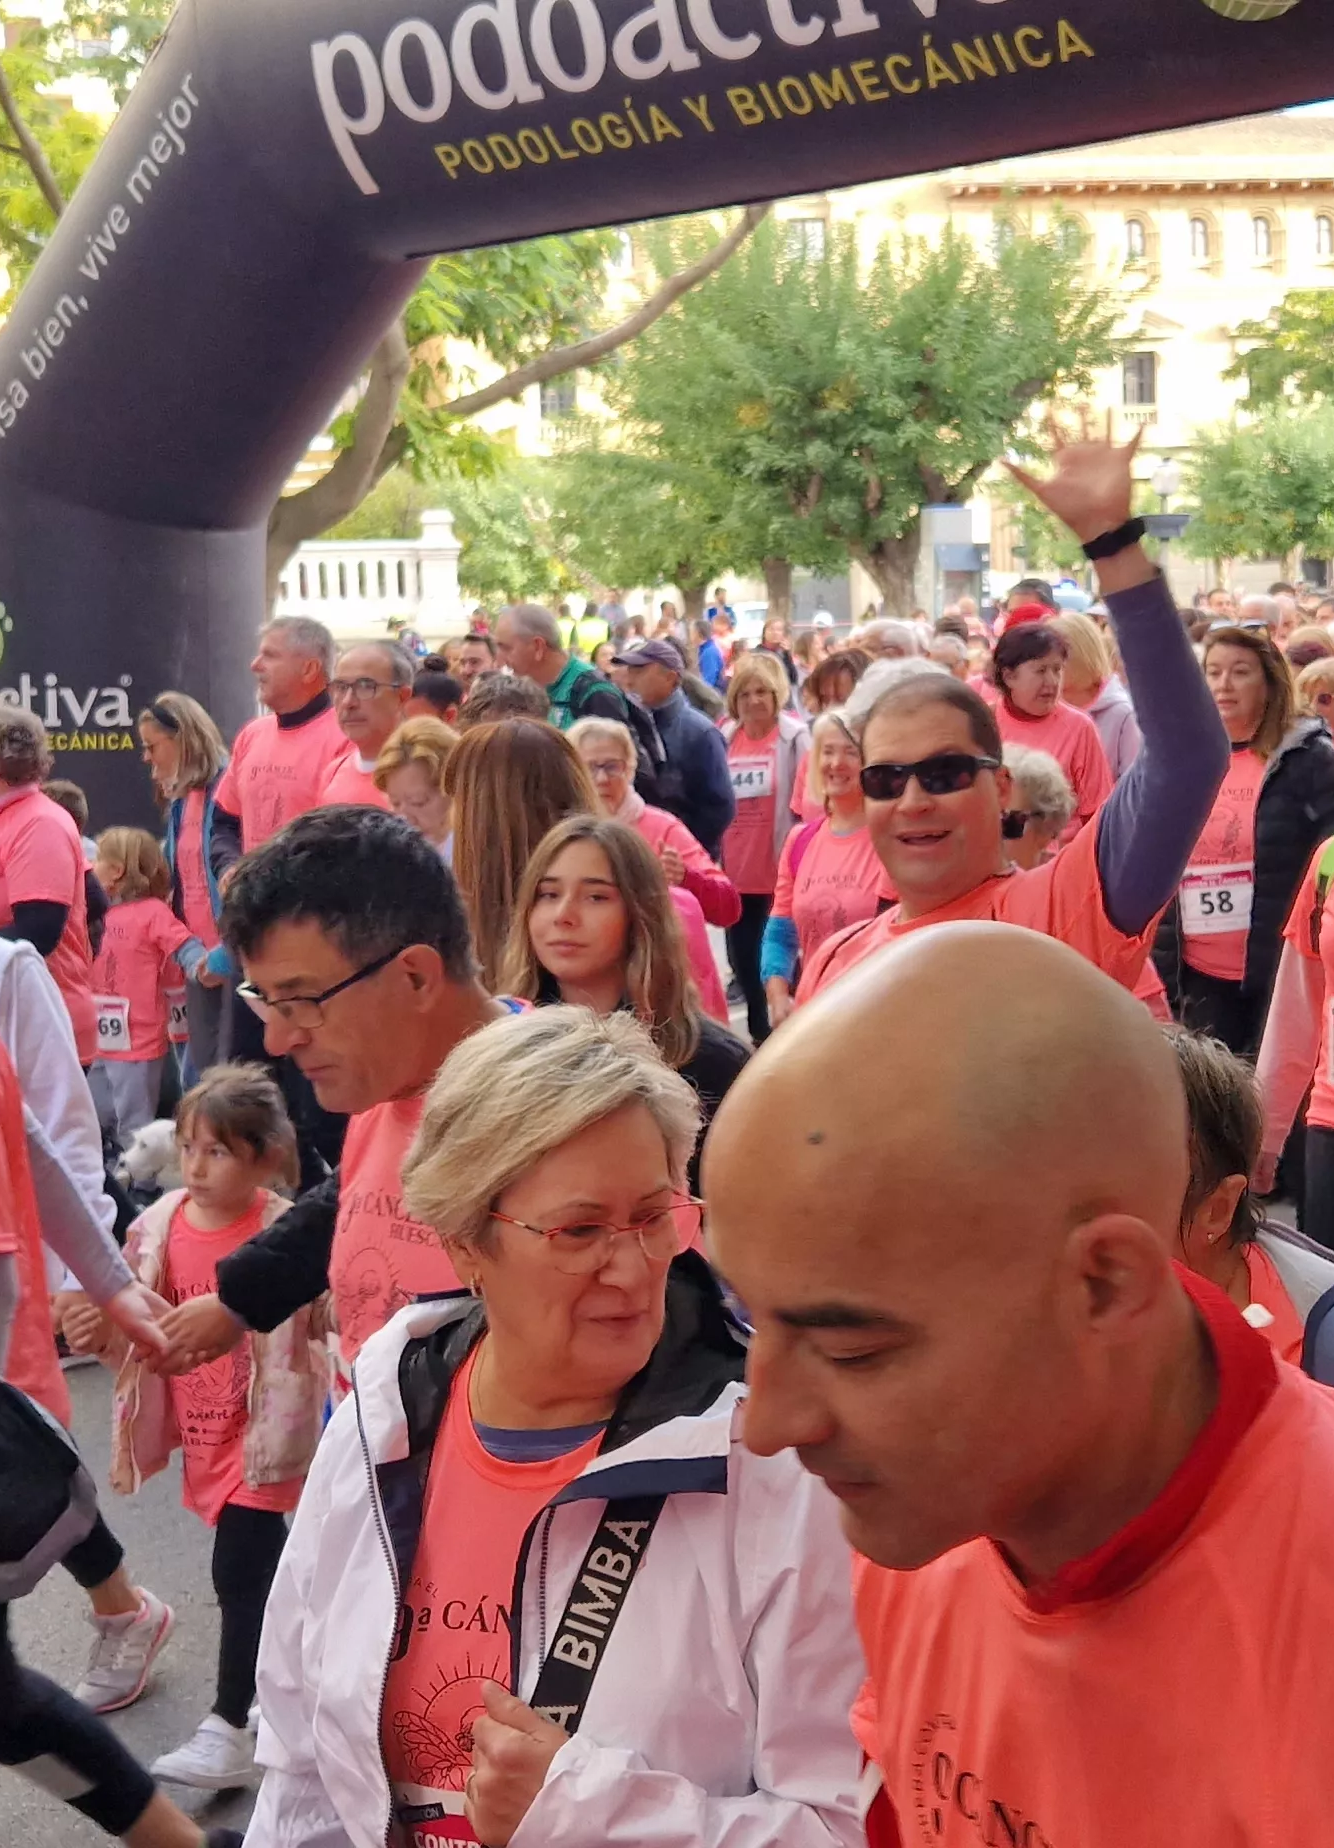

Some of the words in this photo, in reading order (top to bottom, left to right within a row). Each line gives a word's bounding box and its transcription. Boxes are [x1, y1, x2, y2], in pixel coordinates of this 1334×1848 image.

[310, 0, 1013, 194] podoac
[433, 97, 683, 181] PODOLOGÍA
[680, 94, 717, 133] Y
[728, 17, 1096, 128] BIOMECÁNICA
[19, 293, 90, 381] bien,
[77, 202, 132, 281] vive
[125, 72, 200, 206] mejor
[1200, 890, 1234, 915] 58
[98, 1016, 122, 1037] 69
[388, 1221, 445, 1249] HUESC
[553, 1519, 651, 1671] BIMBA
